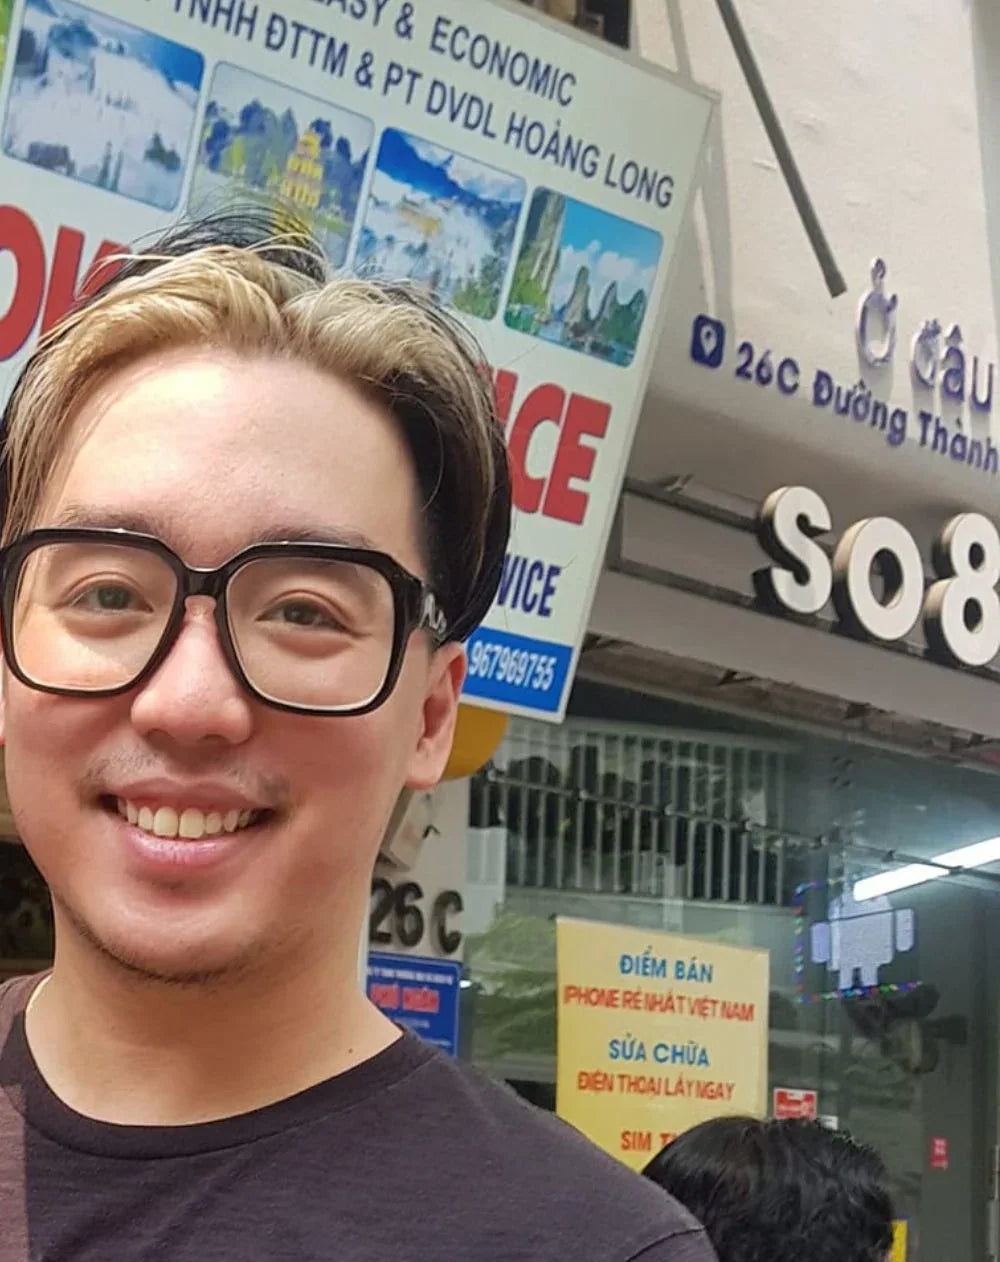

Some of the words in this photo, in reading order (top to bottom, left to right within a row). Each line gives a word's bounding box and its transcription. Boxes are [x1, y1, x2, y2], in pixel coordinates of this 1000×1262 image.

[312, 0, 388, 26] SY
[394, 2, 415, 40] &
[429, 15, 577, 107] ECONOMIC
[264, 13, 349, 79] ĐTTM
[354, 51, 375, 89] &
[382, 62, 423, 104] PT
[425, 80, 497, 139] DVDL
[604, 154, 674, 208] LONG
[735, 341, 799, 395] 26C
[812, 369, 908, 447] Đường
[919, 411, 1000, 475] Thành
[619, 945, 667, 979] ĐIỂM
[675, 956, 714, 983] BÁN
[721, 1000, 756, 1022] NAM
[621, 1131, 652, 1152] SIM
